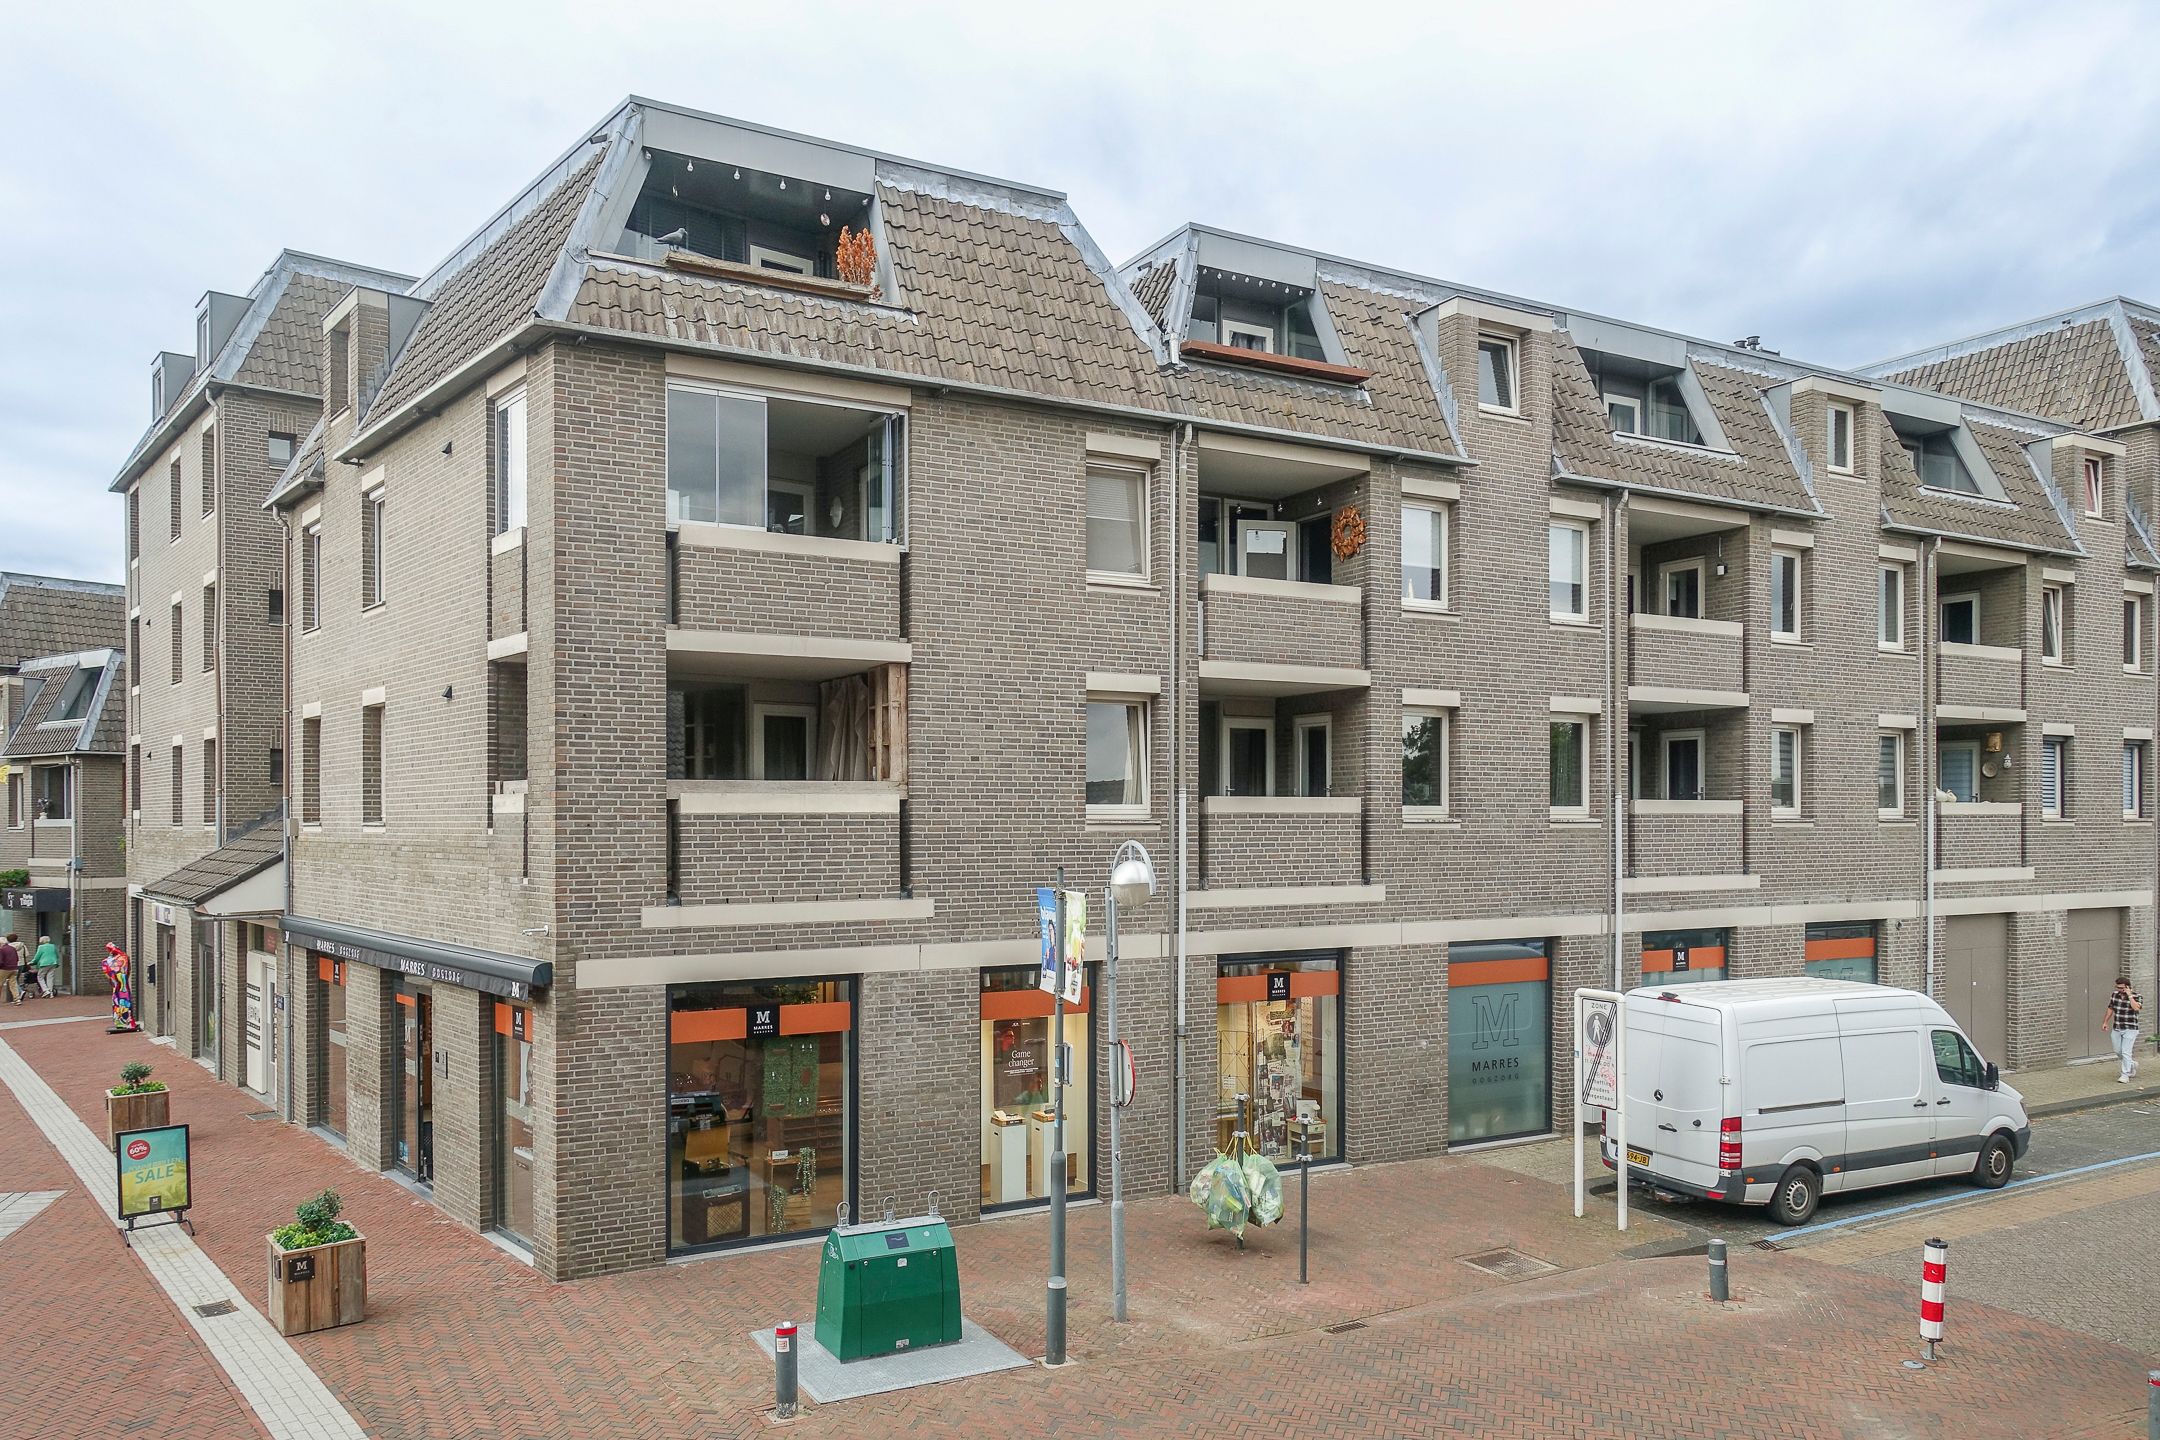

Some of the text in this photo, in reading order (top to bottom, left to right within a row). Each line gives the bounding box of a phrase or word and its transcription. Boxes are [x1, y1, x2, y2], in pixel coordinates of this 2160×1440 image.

[1677, 951, 1685, 961] M
[316, 940, 335, 954] MARRES
[400, 959, 426, 976] MARRES
[432, 967, 461, 983] OOGZORG
[511, 981, 520, 998] M
[1273, 977, 1284, 989] M
[1591, 1003, 1608, 1011] ZONE
[515, 1011, 522, 1025] M
[756, 1010, 771, 1024] M
[1472, 993, 1520, 1050] M
[1011, 1050, 1031, 1059] Game
[1008, 1058, 1035, 1068] changer
[1472, 1057, 1519, 1072] MARRES
[129, 1145, 148, 1155] 60%
[135, 1164, 175, 1185] SALE
[296, 1260, 308, 1271] M
